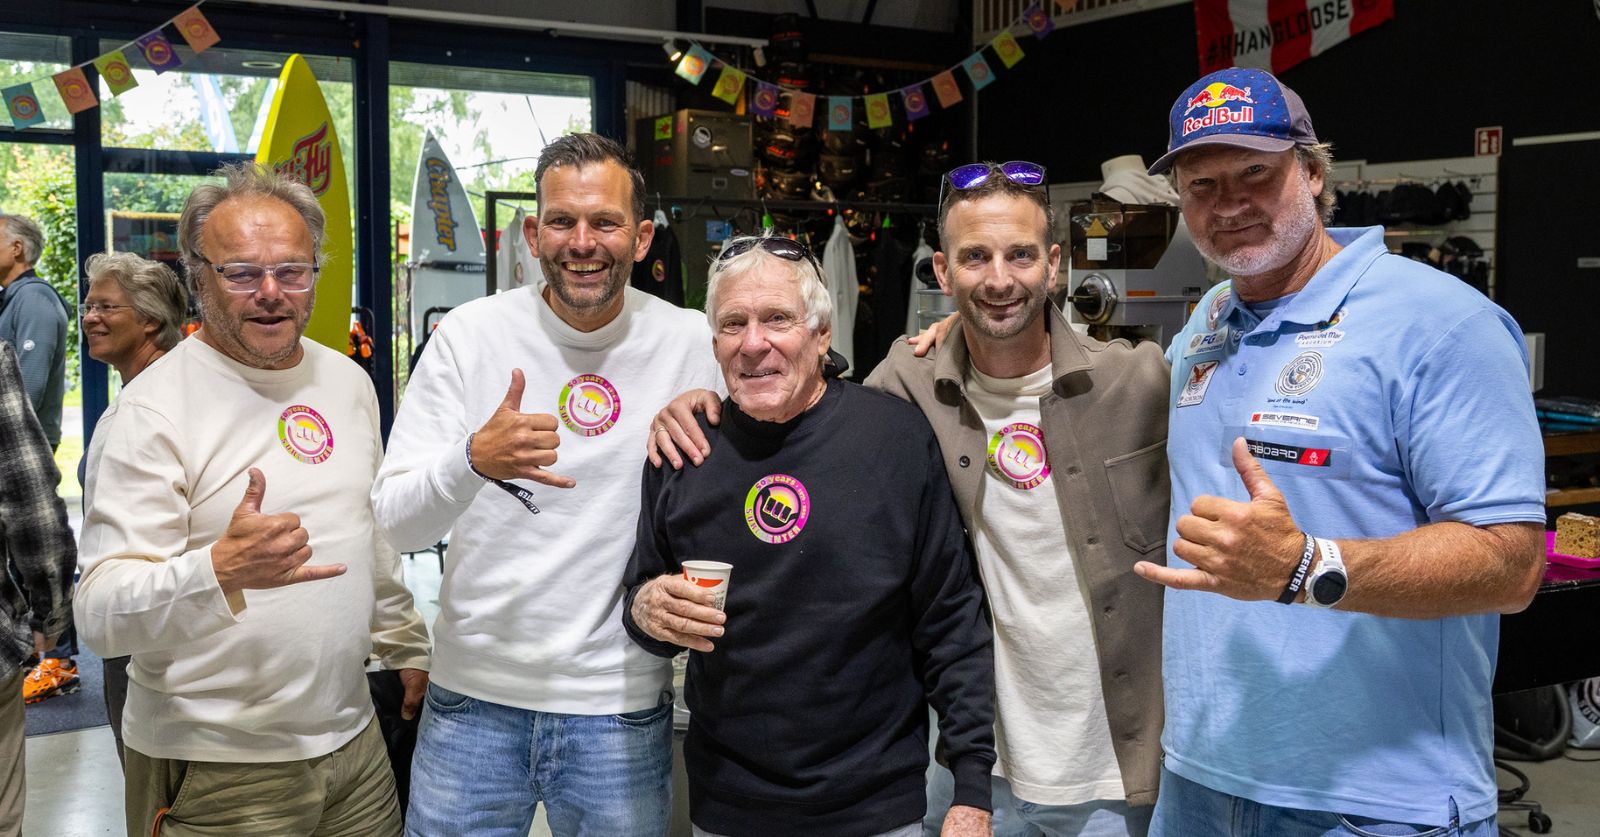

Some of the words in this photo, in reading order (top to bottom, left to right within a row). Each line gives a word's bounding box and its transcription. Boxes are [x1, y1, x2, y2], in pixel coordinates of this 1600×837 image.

[1205, 1, 1349, 67] #HHANGLOOSE
[1183, 108, 1214, 136] Red
[1216, 106, 1253, 125] Bull
[1012, 424, 1038, 434] years
[755, 480, 767, 490] 50
[768, 475, 796, 486] years
